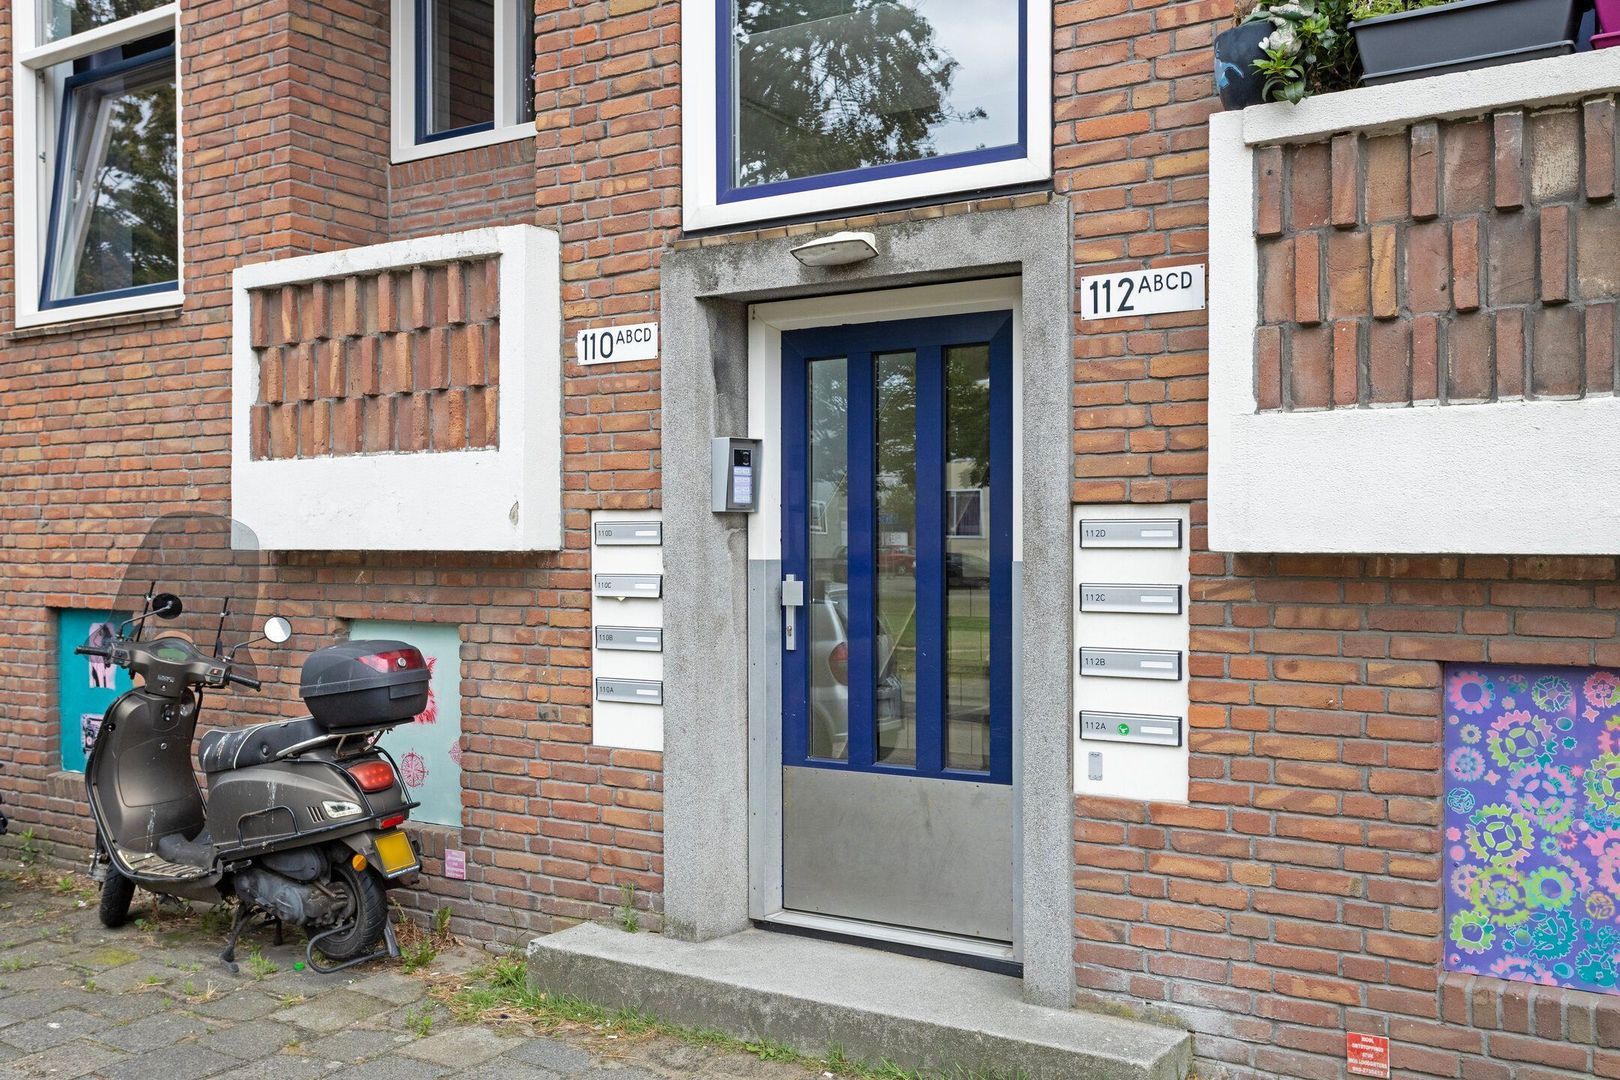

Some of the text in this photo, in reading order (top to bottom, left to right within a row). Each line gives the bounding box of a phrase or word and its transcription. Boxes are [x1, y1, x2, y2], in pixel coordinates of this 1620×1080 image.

[1089, 271, 1193, 315] 112 ABCD
[582, 327, 652, 361] 110 ABCD
[1085, 529, 1106, 538] 112D
[1085, 593, 1106, 602] 112C
[1085, 657, 1106, 666] 112B
[1085, 721, 1107, 731] 112A
